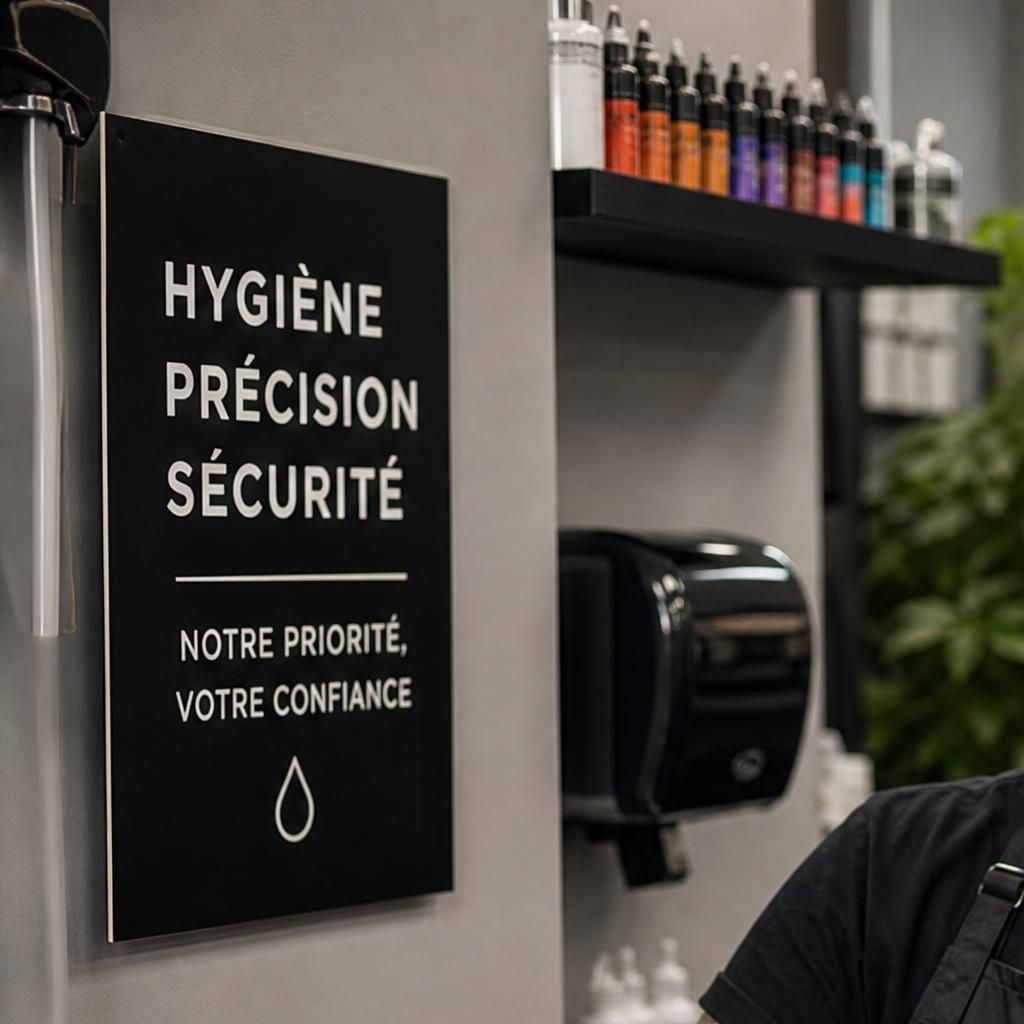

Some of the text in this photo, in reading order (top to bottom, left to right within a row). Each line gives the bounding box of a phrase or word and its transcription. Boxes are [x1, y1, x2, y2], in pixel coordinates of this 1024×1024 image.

[164, 260, 383, 339] HYGIÈNE
[166, 353, 418, 431] PRÉCISION
[166, 447, 404, 521] SÉCURITÉ
[180, 613, 408, 662] NOTRE PRIORITÉ,
[175, 677, 412, 723] VOTRE CONFIANCE
